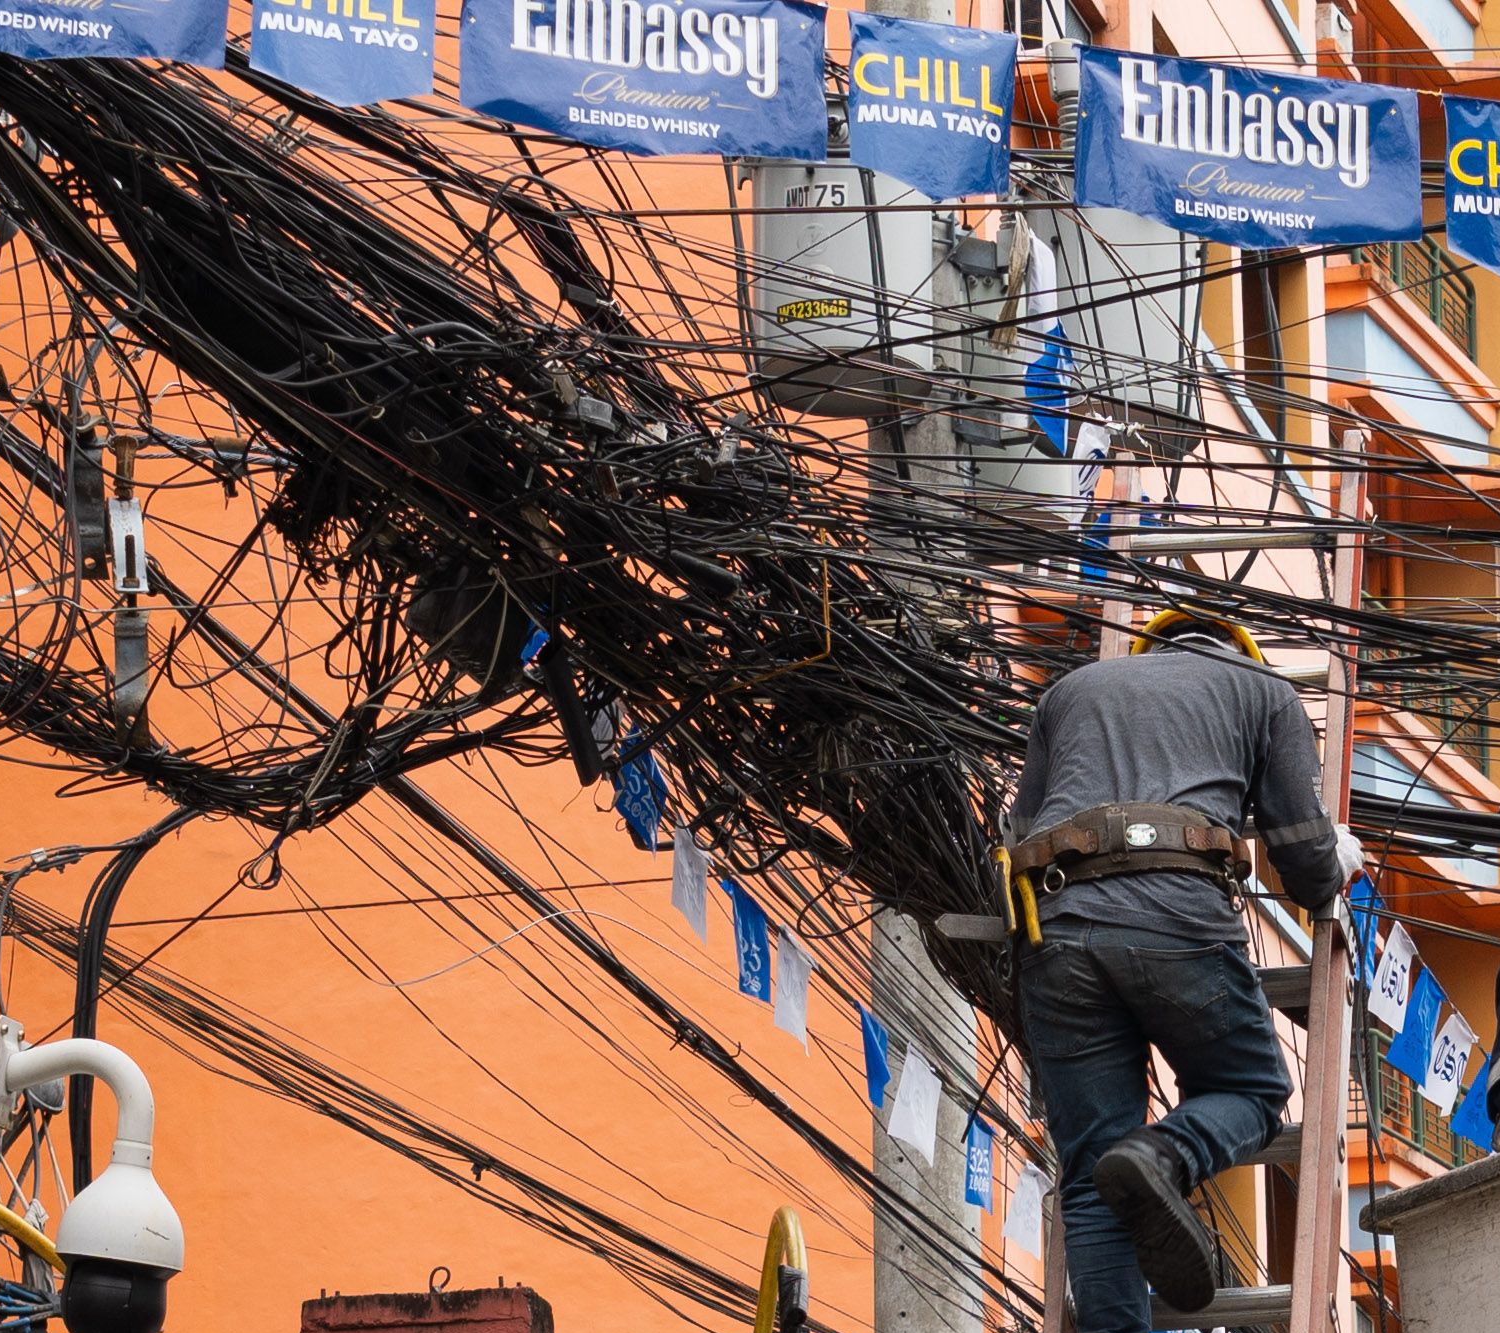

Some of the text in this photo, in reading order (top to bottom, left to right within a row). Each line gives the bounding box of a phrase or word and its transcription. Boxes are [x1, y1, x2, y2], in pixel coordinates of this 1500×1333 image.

[38, 16, 114, 40] WHISKY
[260, 11, 344, 42] MUNA
[349, 25, 419, 52] TAYO
[853, 53, 1003, 117] CHILL
[568, 106, 721, 139] BLENDED WHISKY
[857, 103, 1002, 144] MUNA TAYO
[1117, 56, 1371, 189] Embassy
[814, 184, 845, 207] 75
[1180, 161, 1306, 202] Premium
[1175, 198, 1316, 230] BLENDED WHISKY
